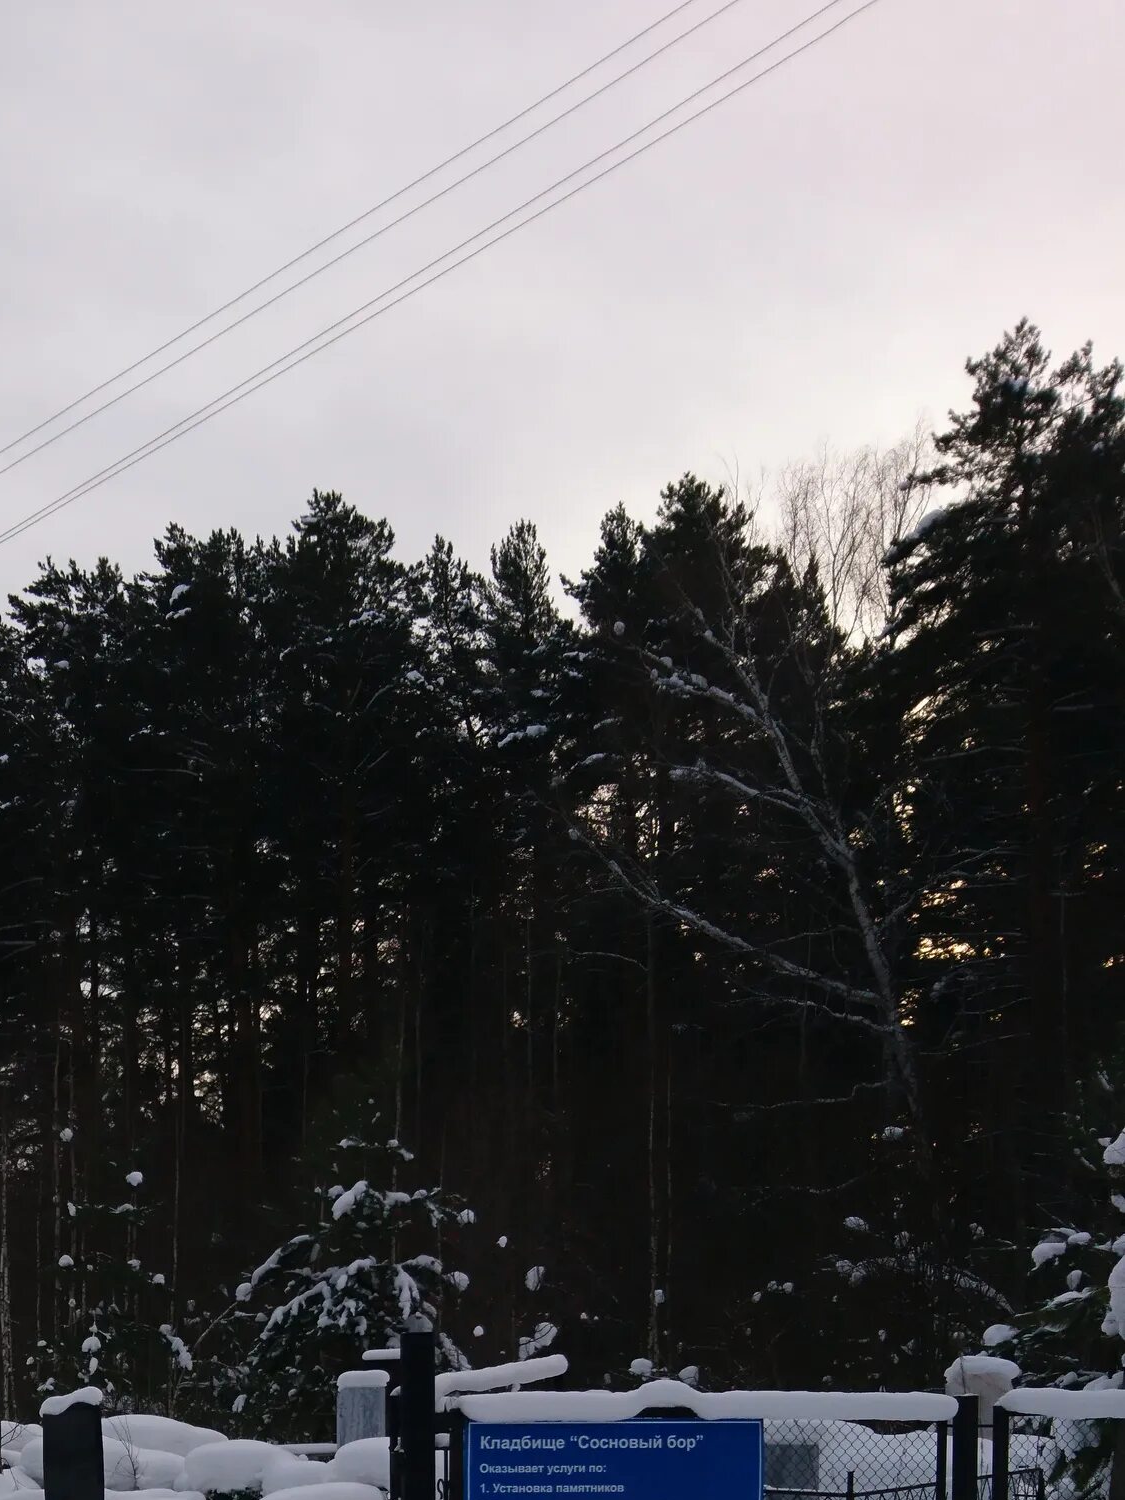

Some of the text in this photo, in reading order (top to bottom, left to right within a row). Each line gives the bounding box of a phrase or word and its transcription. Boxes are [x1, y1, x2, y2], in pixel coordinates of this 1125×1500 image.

[480, 1435, 566, 1452] Кладбище
[479, 1462, 607, 1476] Оказывает услуги по:
[479, 1482, 625, 1494] 1. Установка памятников
